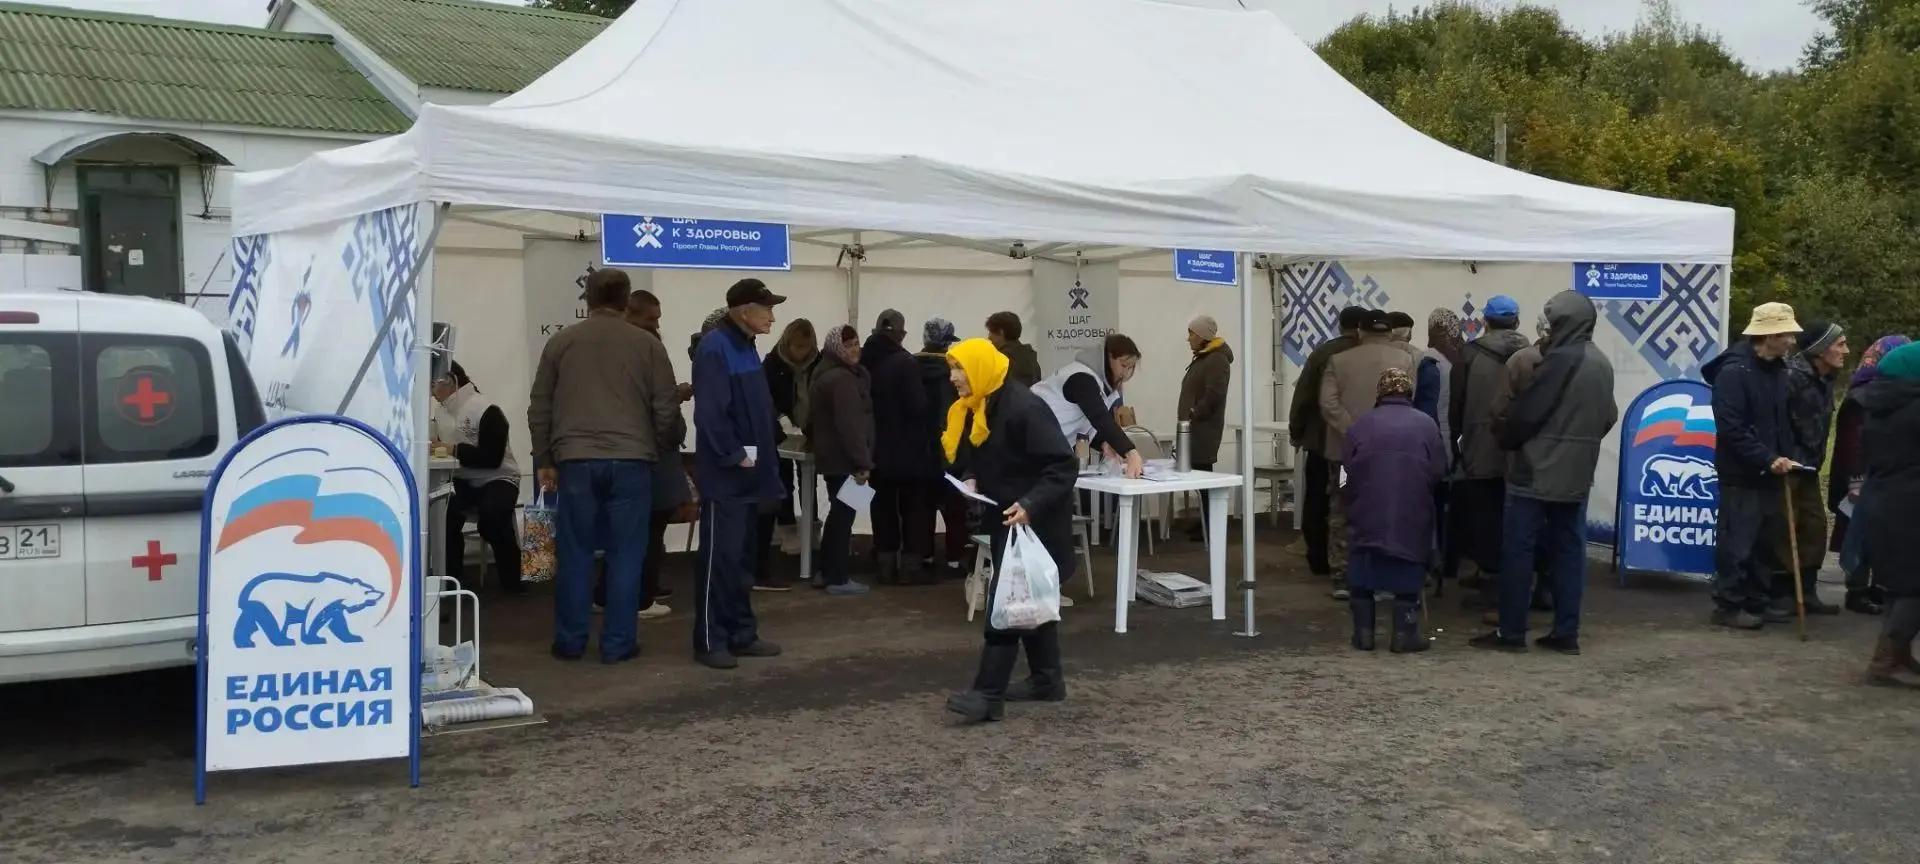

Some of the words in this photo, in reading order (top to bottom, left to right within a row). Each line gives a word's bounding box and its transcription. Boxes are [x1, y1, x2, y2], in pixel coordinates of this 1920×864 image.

[672, 228, 681, 237] К
[686, 228, 761, 240] ЗДОРОВЬЮ
[1603, 272, 1609, 280] К
[1610, 272, 1649, 281] ЗДОРОВЬЮ
[1068, 315, 1092, 325] ШАГ
[1047, 328, 1055, 339] К
[20, 527, 48, 547] 21
[1634, 524, 1717, 546] РОССИ
[226, 667, 393, 702] ЕДИНАЯ
[226, 699, 393, 735] РОССИЯ
